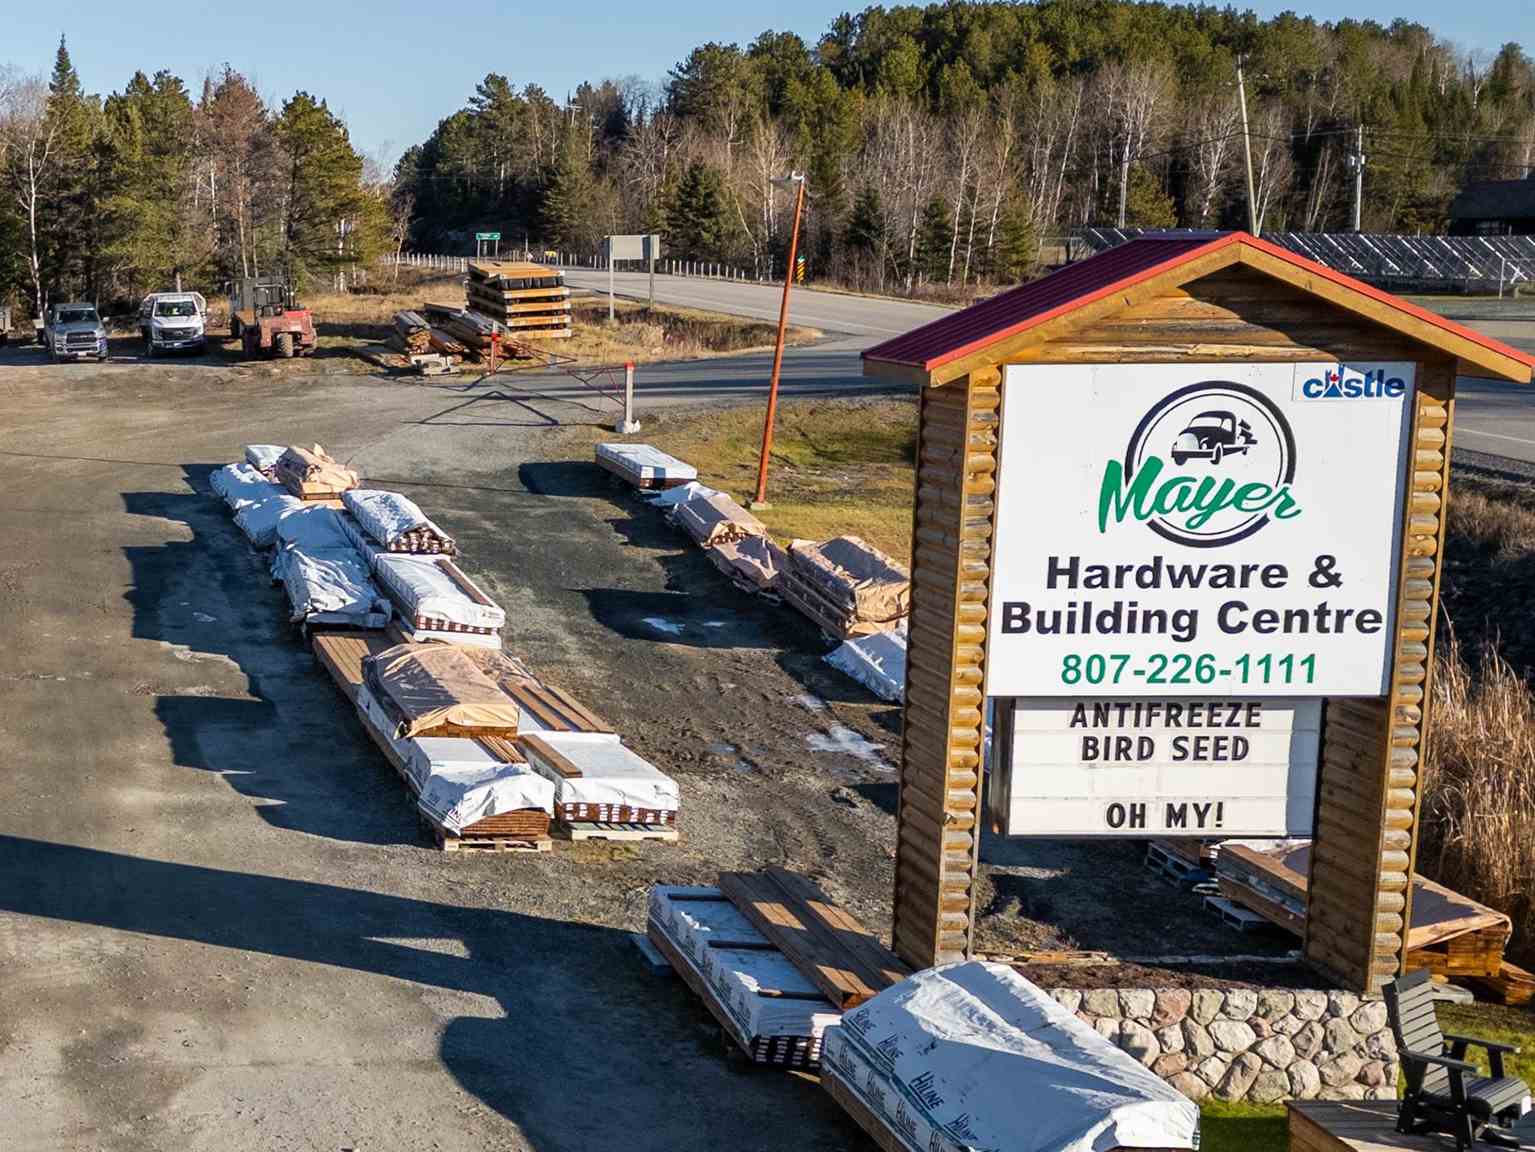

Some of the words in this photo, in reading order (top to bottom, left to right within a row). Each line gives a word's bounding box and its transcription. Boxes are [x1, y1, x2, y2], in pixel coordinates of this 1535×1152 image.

[1099, 455, 1302, 534] Mayer
[1046, 555, 1289, 590] Hardware
[1308, 554, 1344, 590] &
[1001, 601, 1199, 643] Building
[1217, 600, 1383, 636] Centre
[1061, 653, 1317, 686] 807-226-1111
[1070, 702, 1262, 729] ANTIFREEZE
[1082, 736, 1155, 762] BIRD
[1172, 736, 1250, 762] SEED
[1106, 804, 1146, 830] OH
[1165, 802, 1224, 830] MY!
